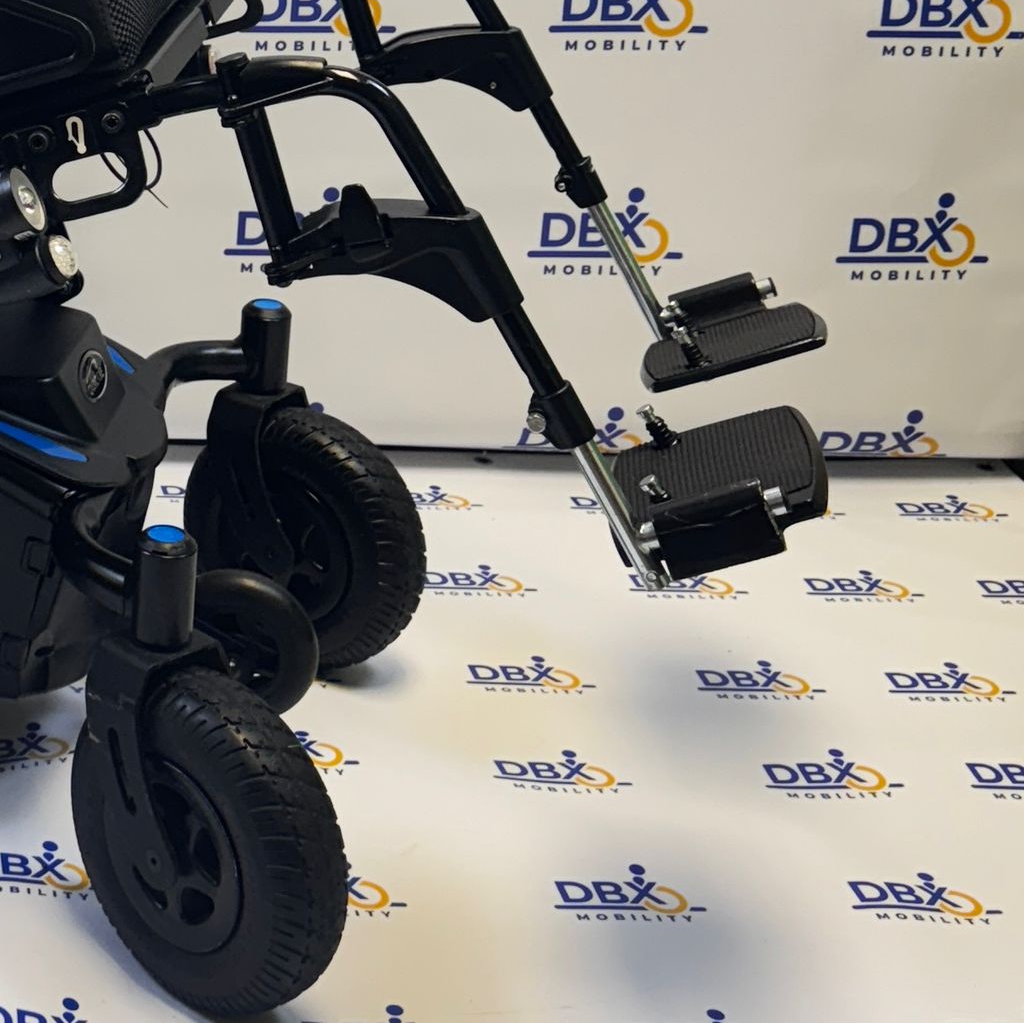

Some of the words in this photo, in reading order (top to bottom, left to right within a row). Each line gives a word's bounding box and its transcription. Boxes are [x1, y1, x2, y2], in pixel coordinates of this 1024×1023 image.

[565, 40, 685, 51] MOBILITY
[883, 46, 1003, 57] MOBILITY
[849, 218, 958, 253] DBX
[543, 265, 662, 276] MOBILY
[851, 270, 966, 280] MOBILITY
[822, 431, 924, 453] DBX
[896, 502, 978, 514] DBX
[804, 578, 893, 593] DBX
[468, 665, 561, 682] DBX
[695, 670, 792, 687] DBX
[885, 673, 981, 689] DBX
[494, 760, 594, 780] DBX
[762, 763, 866, 784] DBX
[787, 791, 891, 800] MOBILITY
[555, 881, 667, 905] DBX
[848, 881, 961, 908] DBX
[577, 913, 692, 923] MOBILITY
[876, 913, 989, 924] MOBILITY
